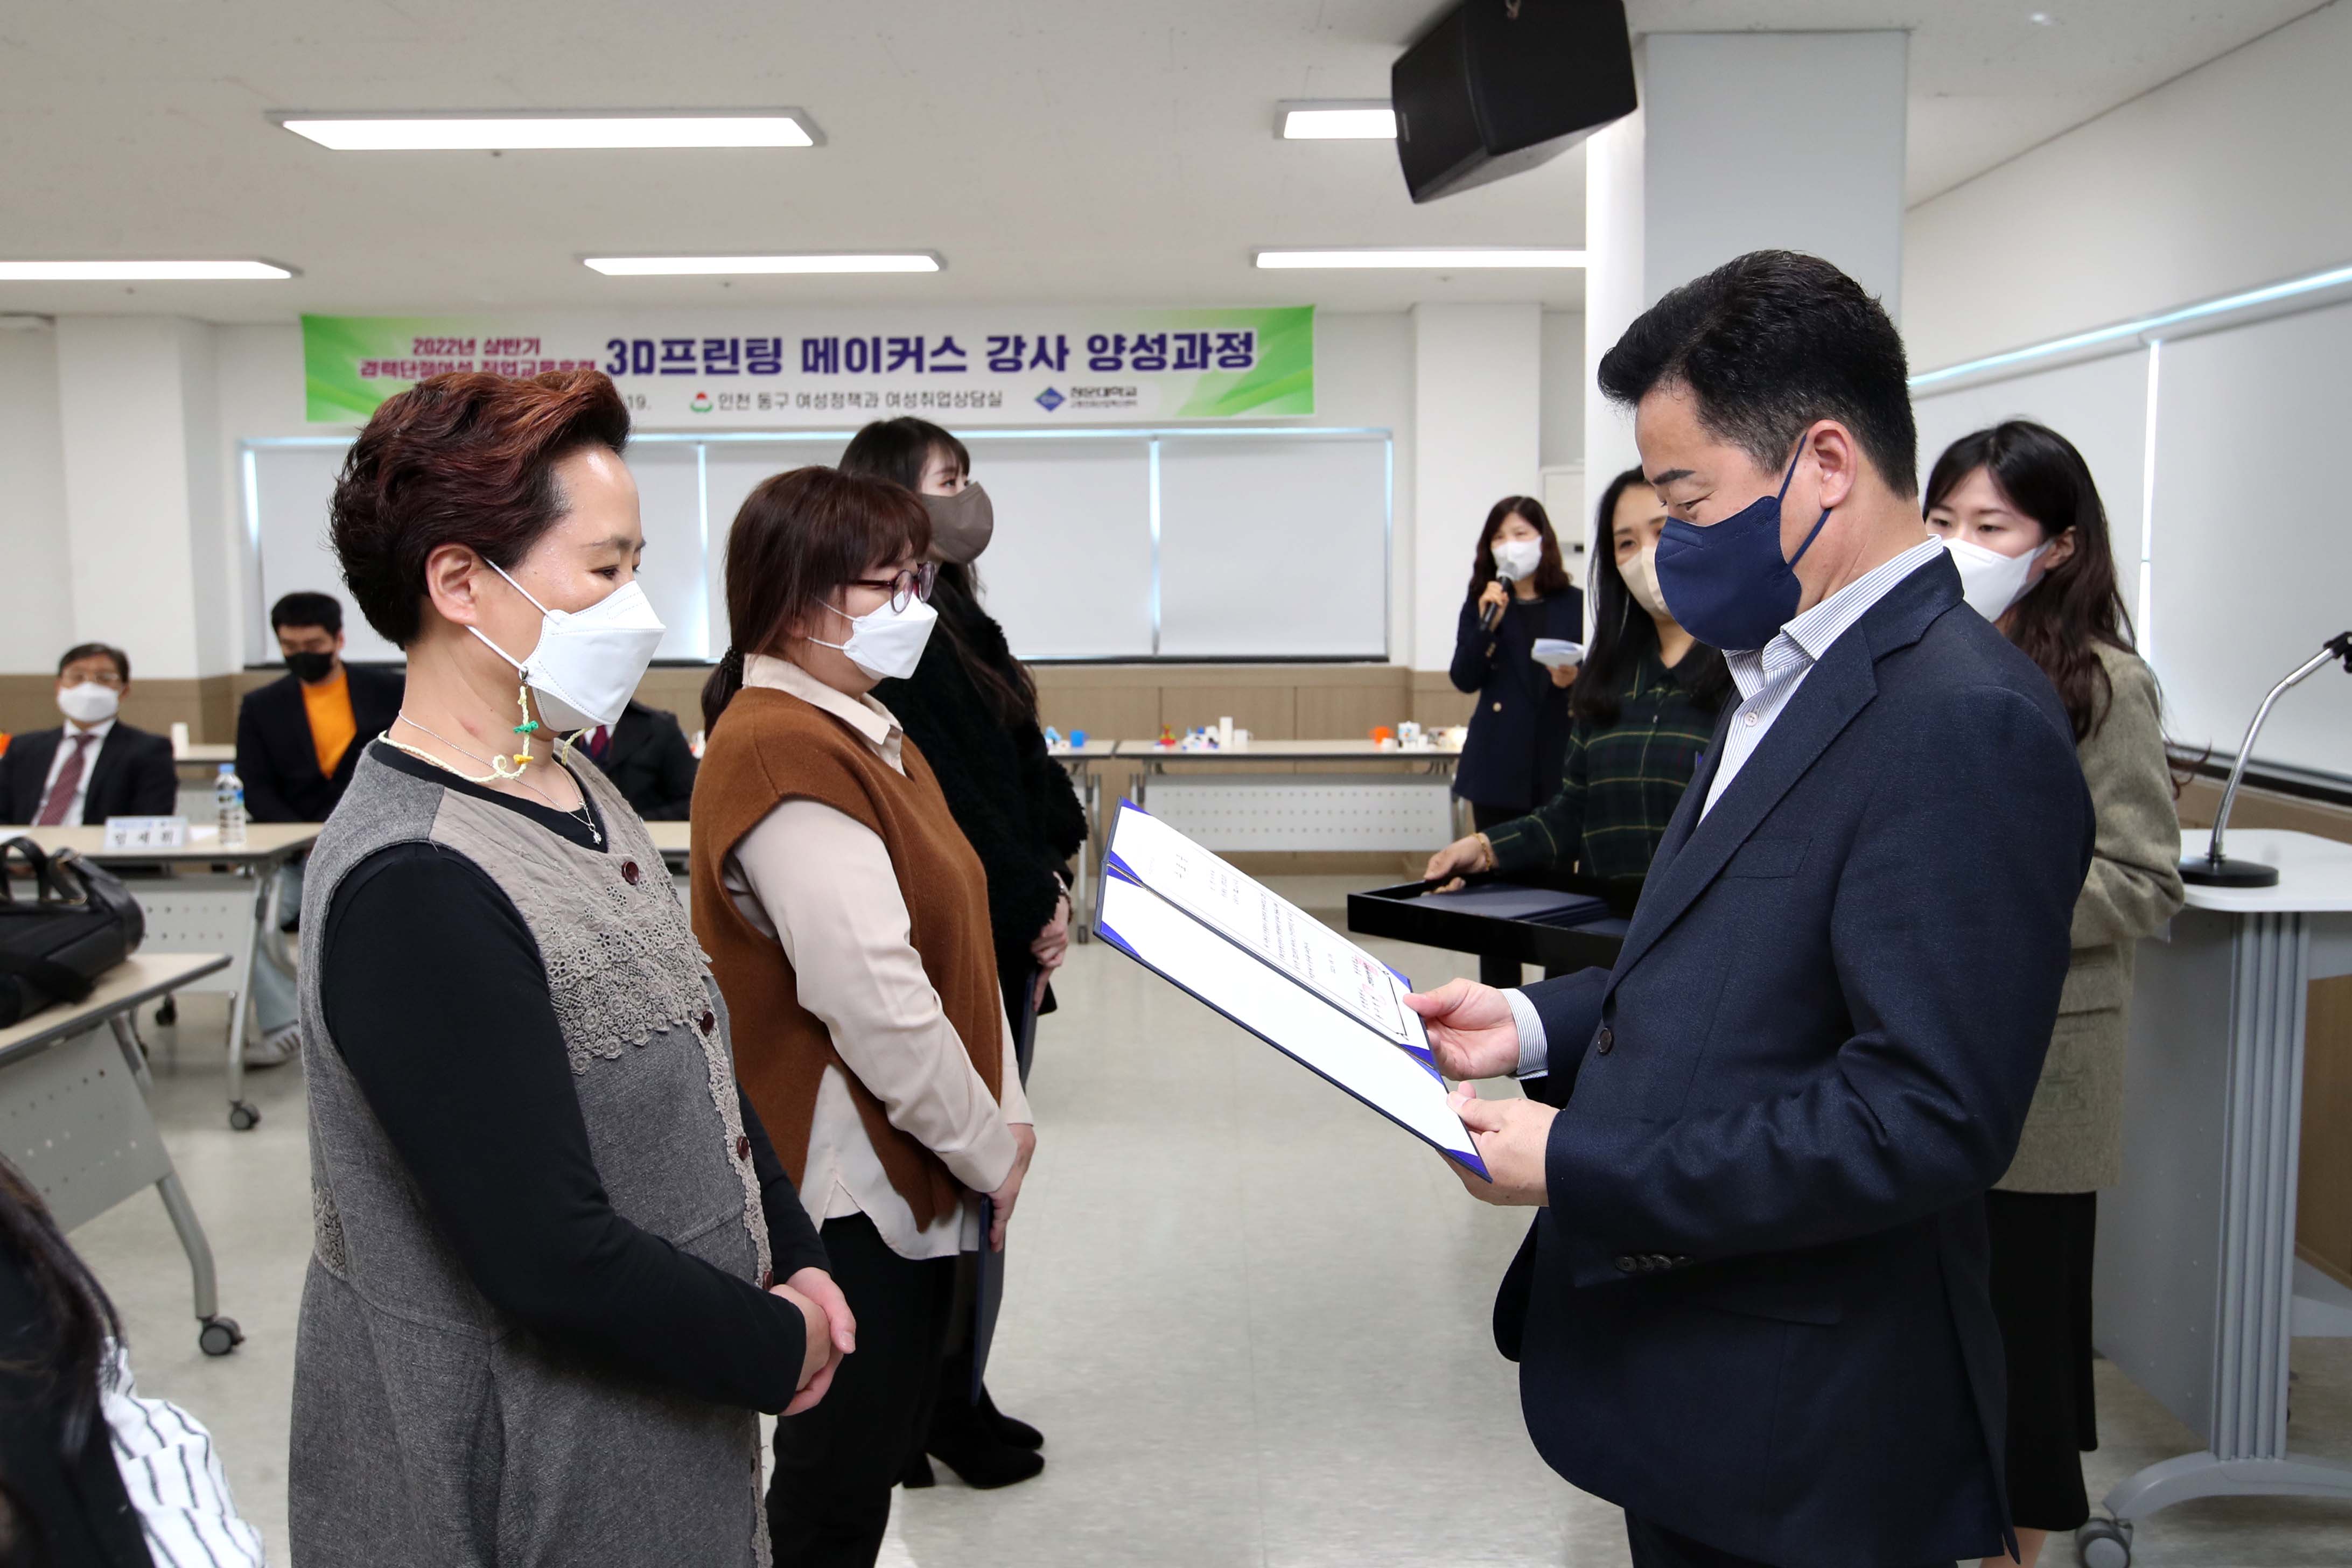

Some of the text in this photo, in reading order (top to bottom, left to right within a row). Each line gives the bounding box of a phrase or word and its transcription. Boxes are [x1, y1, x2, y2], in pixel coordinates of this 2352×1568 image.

[412, 338, 541, 356] 2022년 상반기
[606, 331, 1254, 375] 3D프린팅 메이커스 강사 양성과정
[718, 390, 1003, 411] 인천 동구 여성정책과 여성취업상담실
